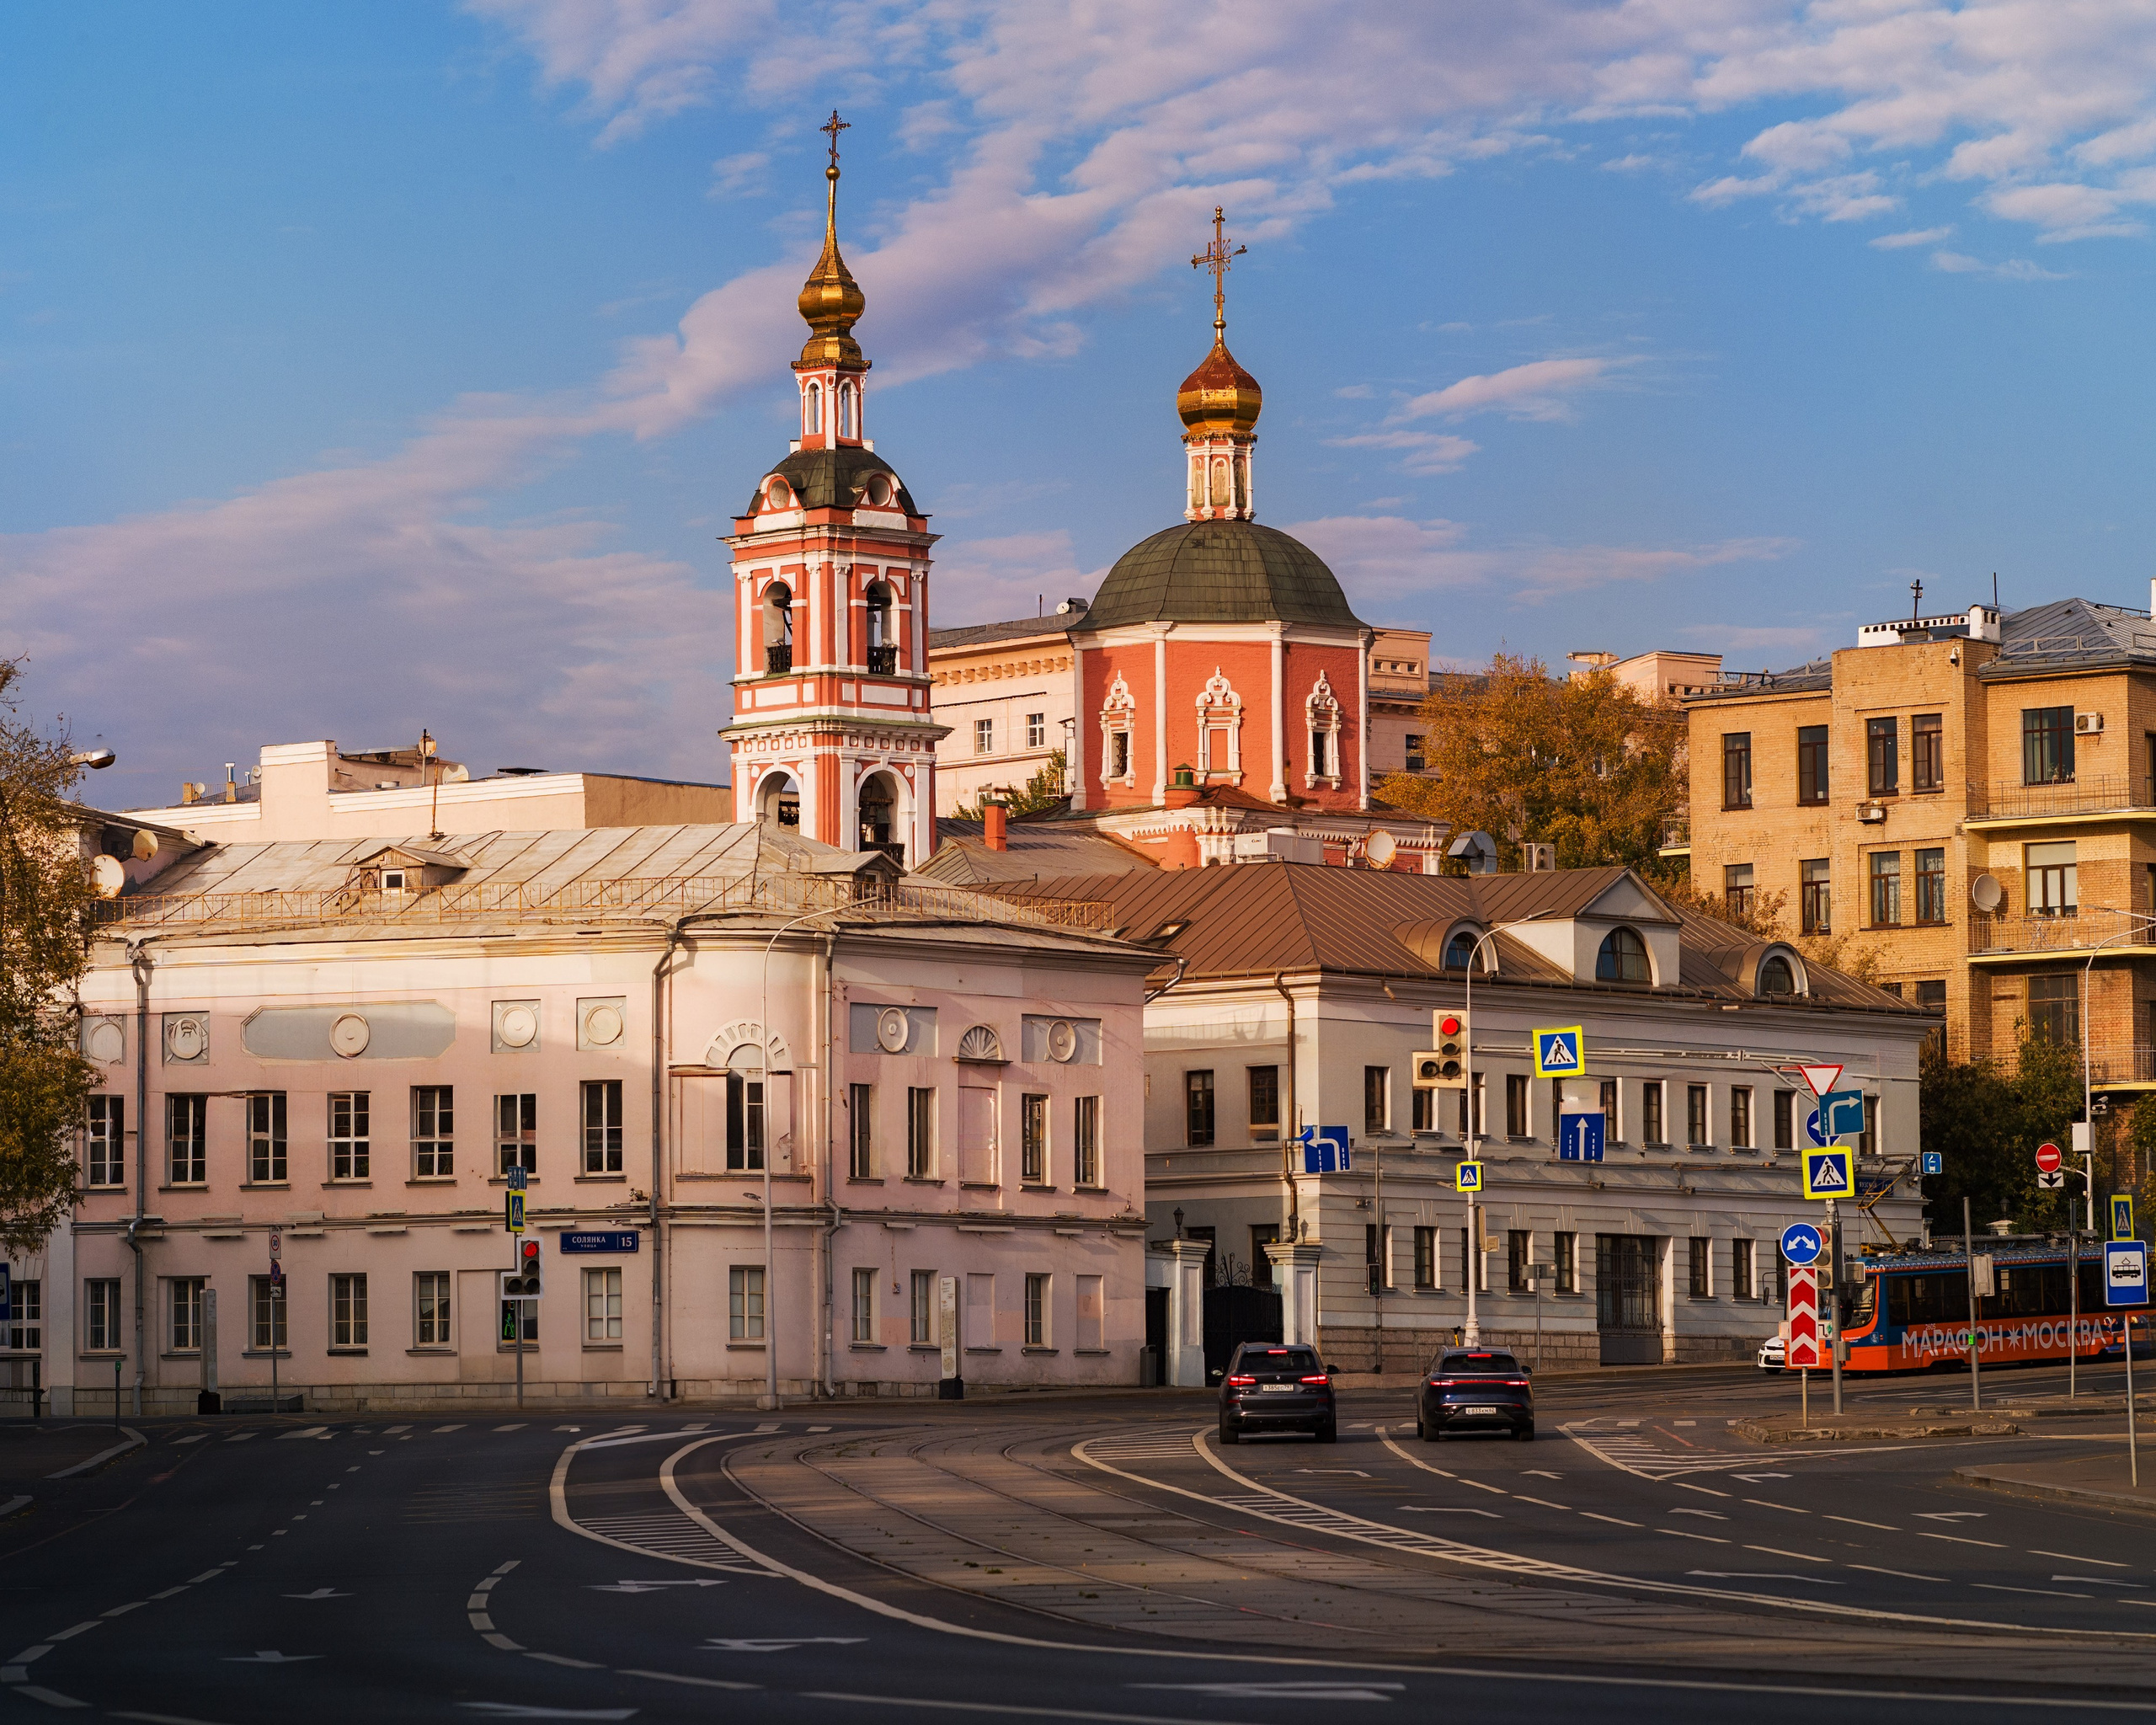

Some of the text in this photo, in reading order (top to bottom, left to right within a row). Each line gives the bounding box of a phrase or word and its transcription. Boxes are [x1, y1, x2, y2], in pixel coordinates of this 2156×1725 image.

[621, 1236, 632, 1247] 15
[1902, 1318, 2107, 1359] МАРАФОН МОСКВА
